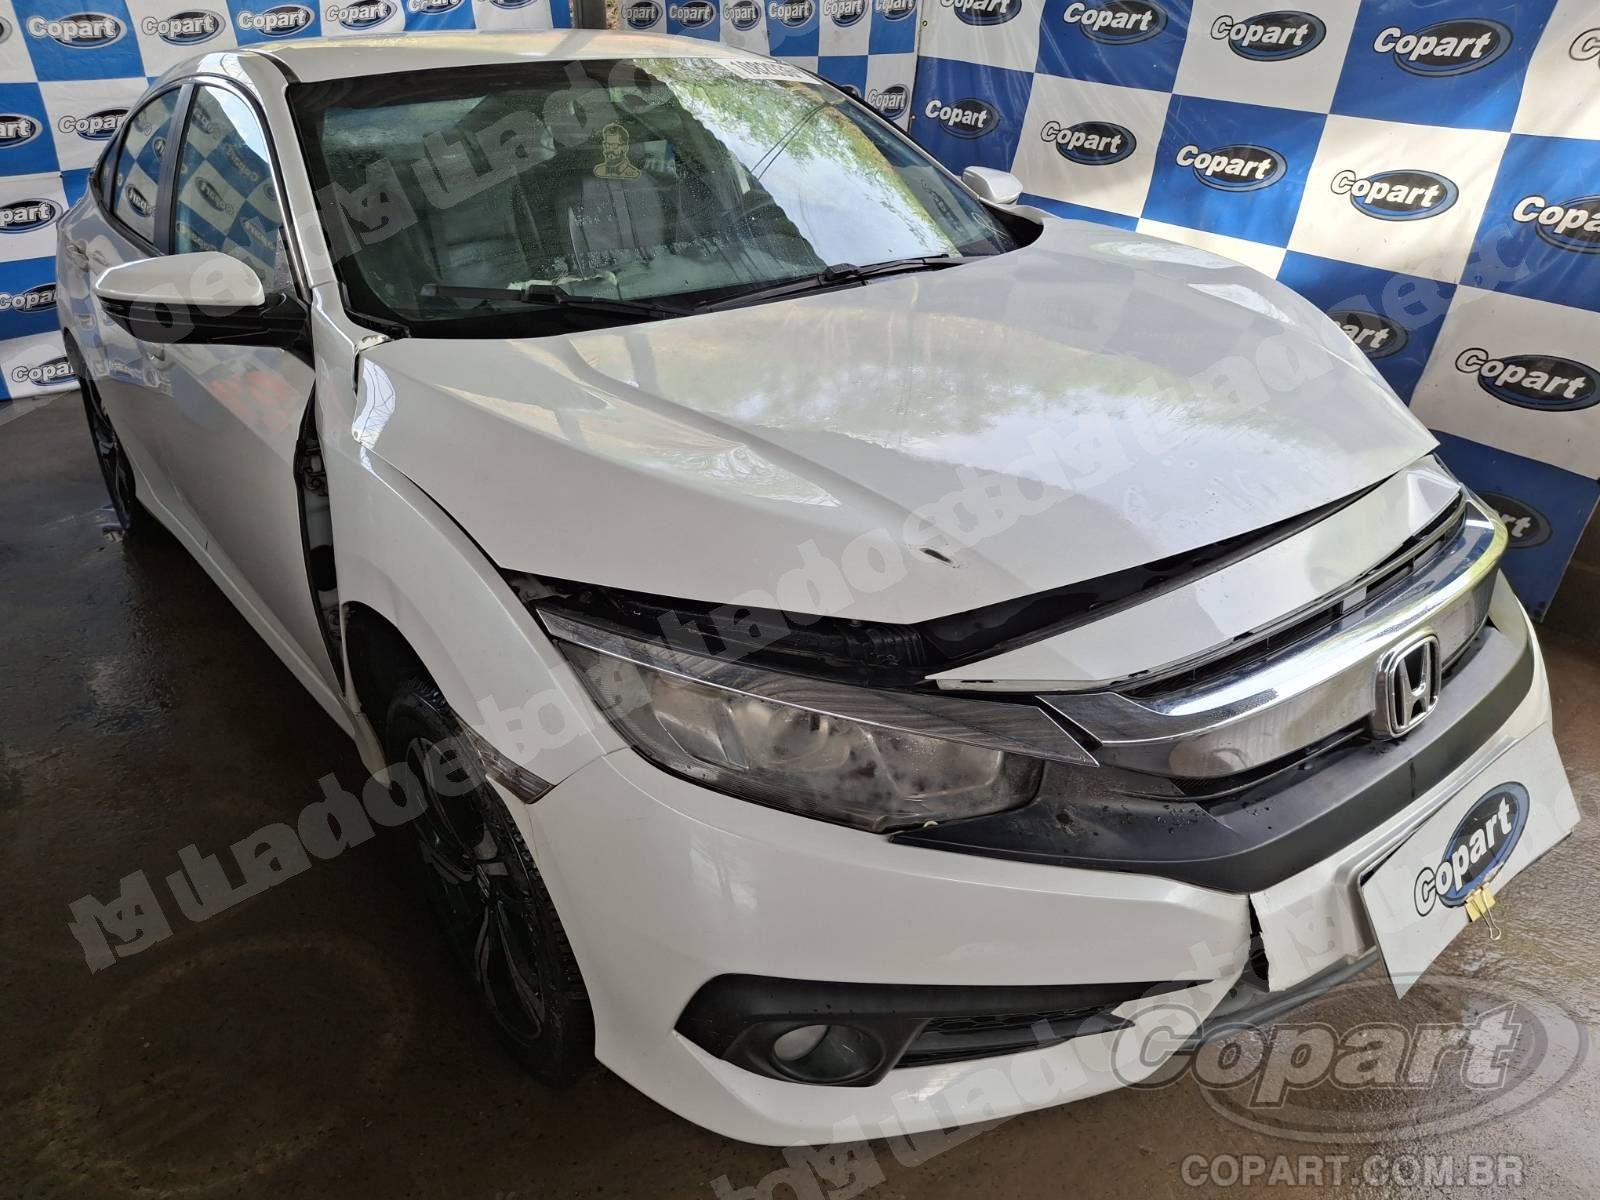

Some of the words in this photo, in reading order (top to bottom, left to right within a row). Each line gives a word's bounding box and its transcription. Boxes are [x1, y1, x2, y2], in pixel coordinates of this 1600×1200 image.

[237, 9, 307, 31] Copart
[326, 2, 388, 22] Copart
[621, 5, 655, 21] Copart
[669, 4, 711, 22] Copart
[723, 4, 757, 20] Copart
[768, 2, 810, 21] Copart
[823, 0, 863, 19] Copart
[1063, 2, 1152, 31] Copart
[27, 17, 117, 42] Copart
[142, 15, 215, 37] Copart
[1210, 15, 1309, 47] Copart
[1373, 27, 1492, 62] Copart
[868, 89, 905, 112] Copart
[925, 100, 988, 128] Copart
[0, 119, 30, 137] art
[1041, 121, 1122, 153] Copart
[1177, 145, 1272, 179] Copart
[1331, 170, 1440, 208] Copart
[0, 202, 49, 227] part
[1512, 196, 1600, 234] Copa
[0, 290, 57, 310] Copa
[1336, 321, 1390, 349] art
[12, 361, 73, 382] Copa
[1455, 347, 1588, 399] Copart
[1414, 797, 1512, 917] Copart
